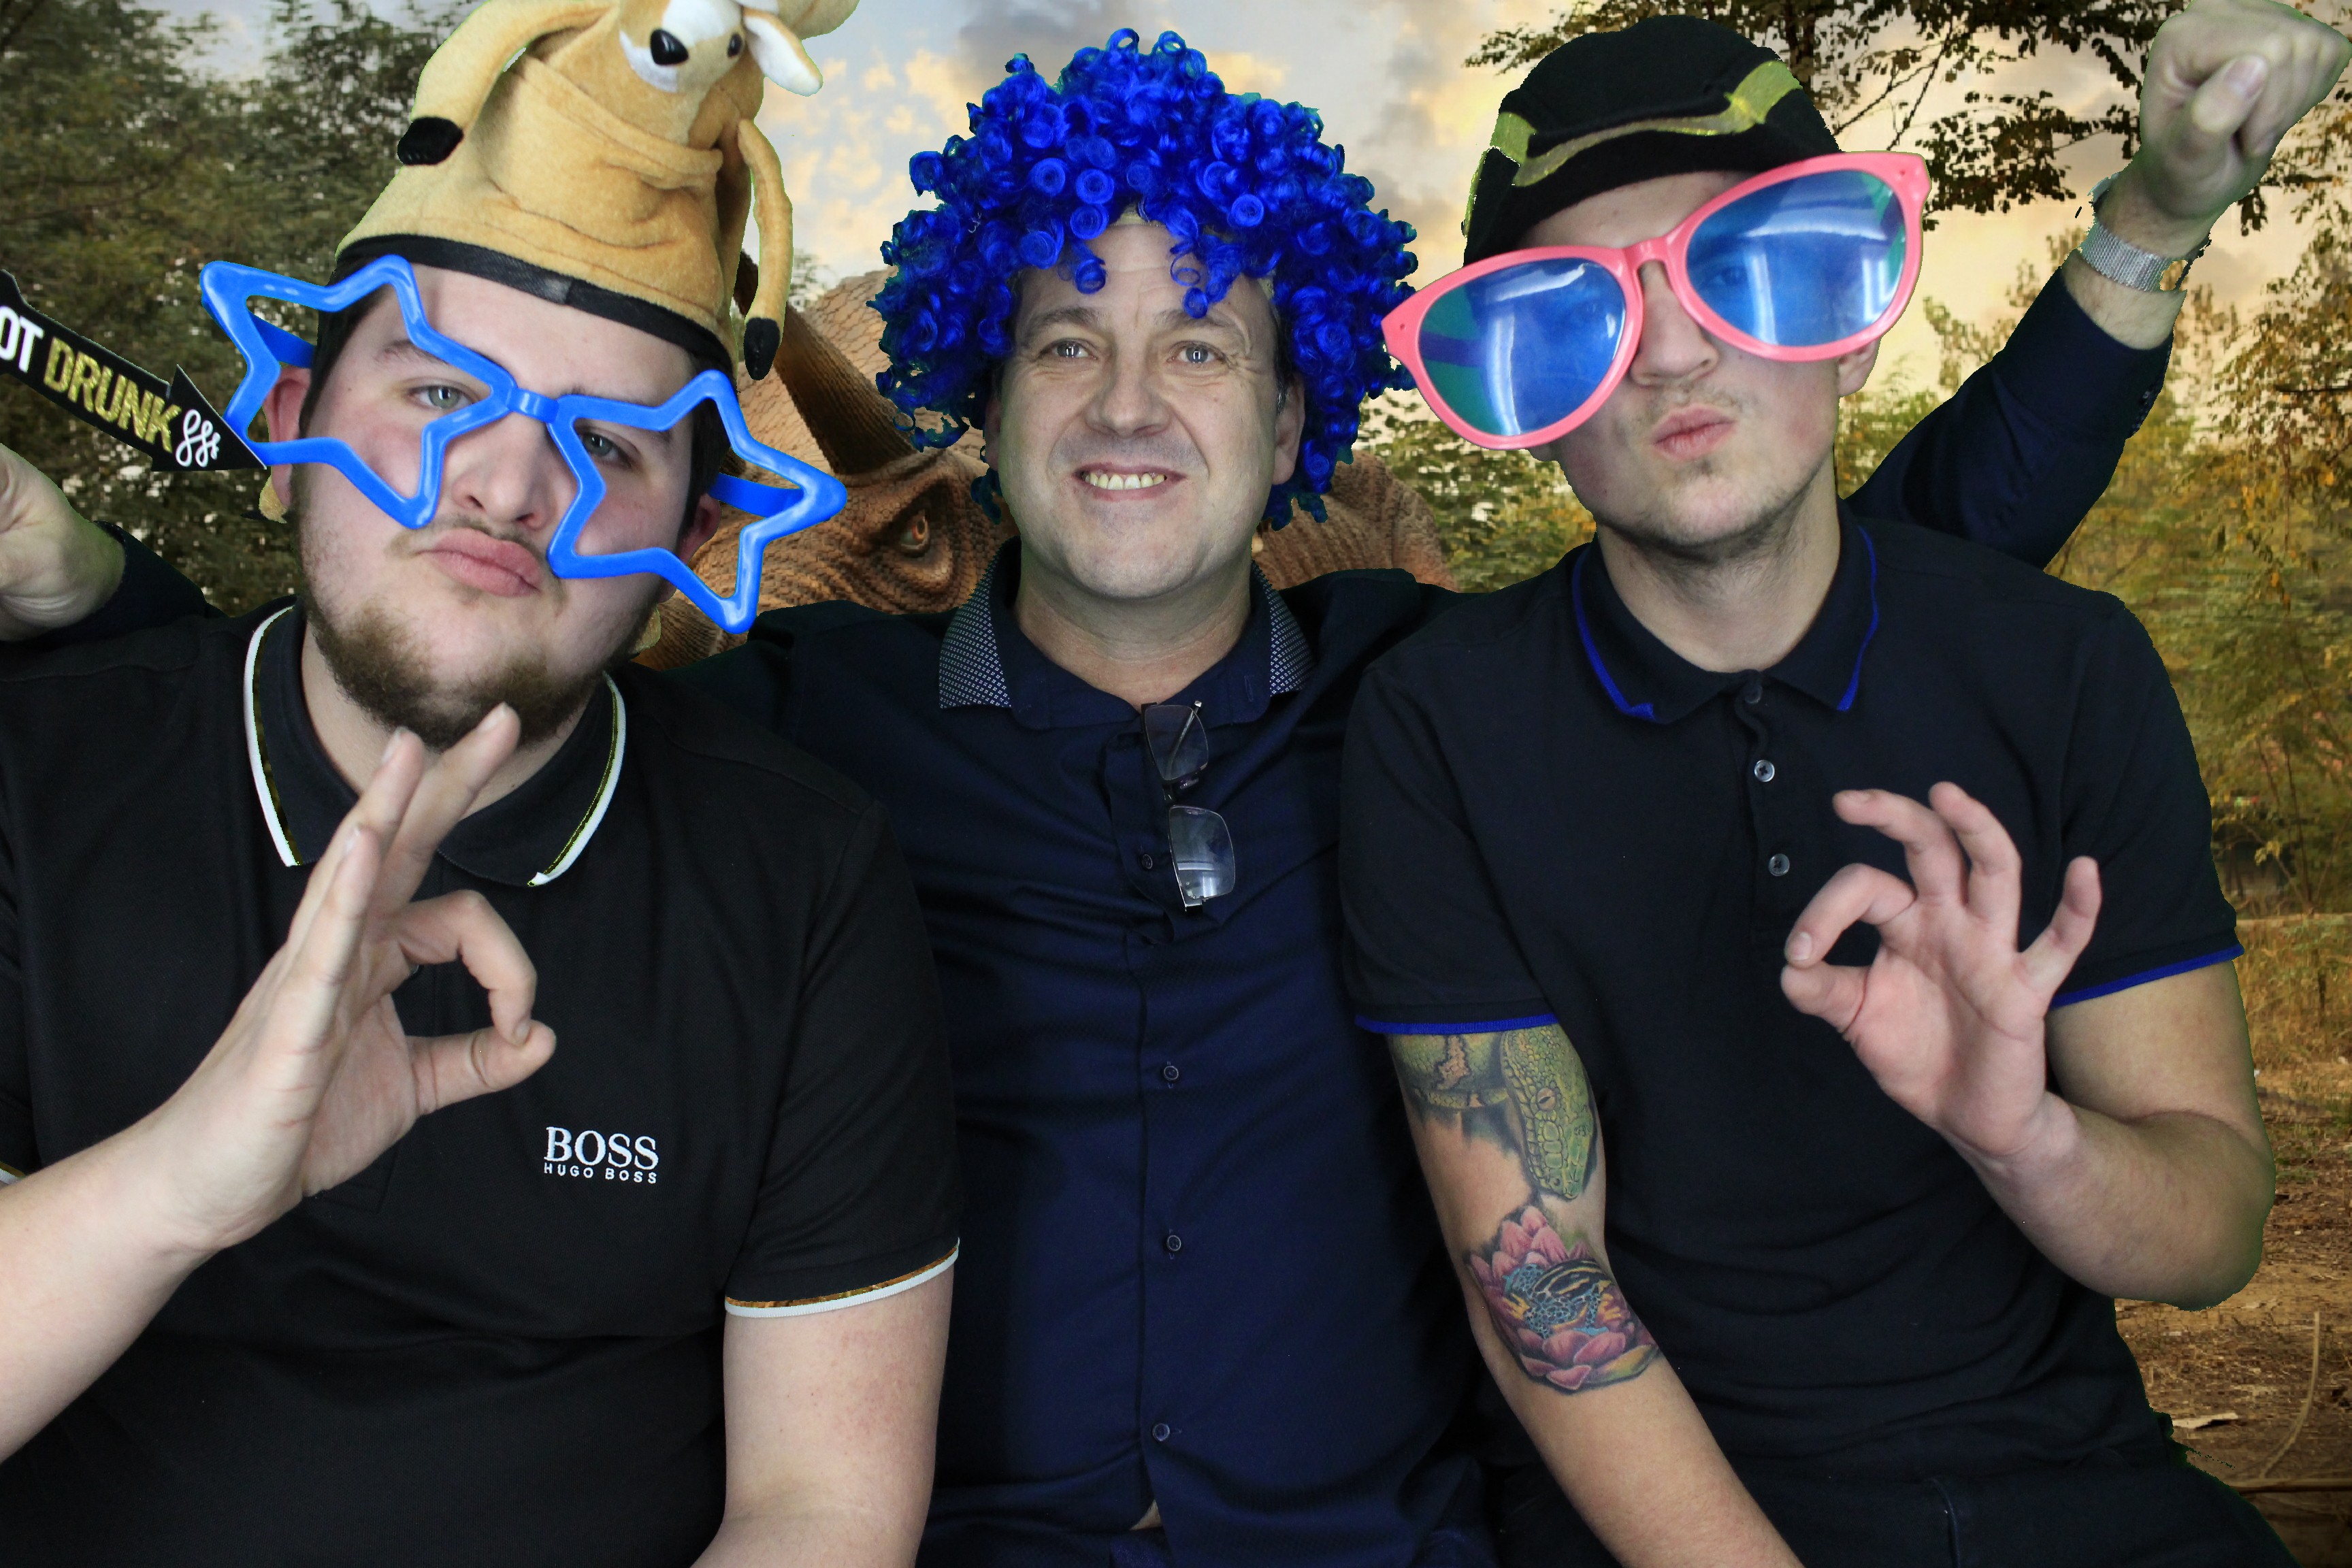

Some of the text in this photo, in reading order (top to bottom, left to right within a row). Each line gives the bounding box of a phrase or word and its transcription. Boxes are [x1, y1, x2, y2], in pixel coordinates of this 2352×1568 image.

[44, 338, 181, 453] DRUNK
[544, 1126, 659, 1170] BOSS
[544, 1162, 657, 1184] HUGO BOSS
